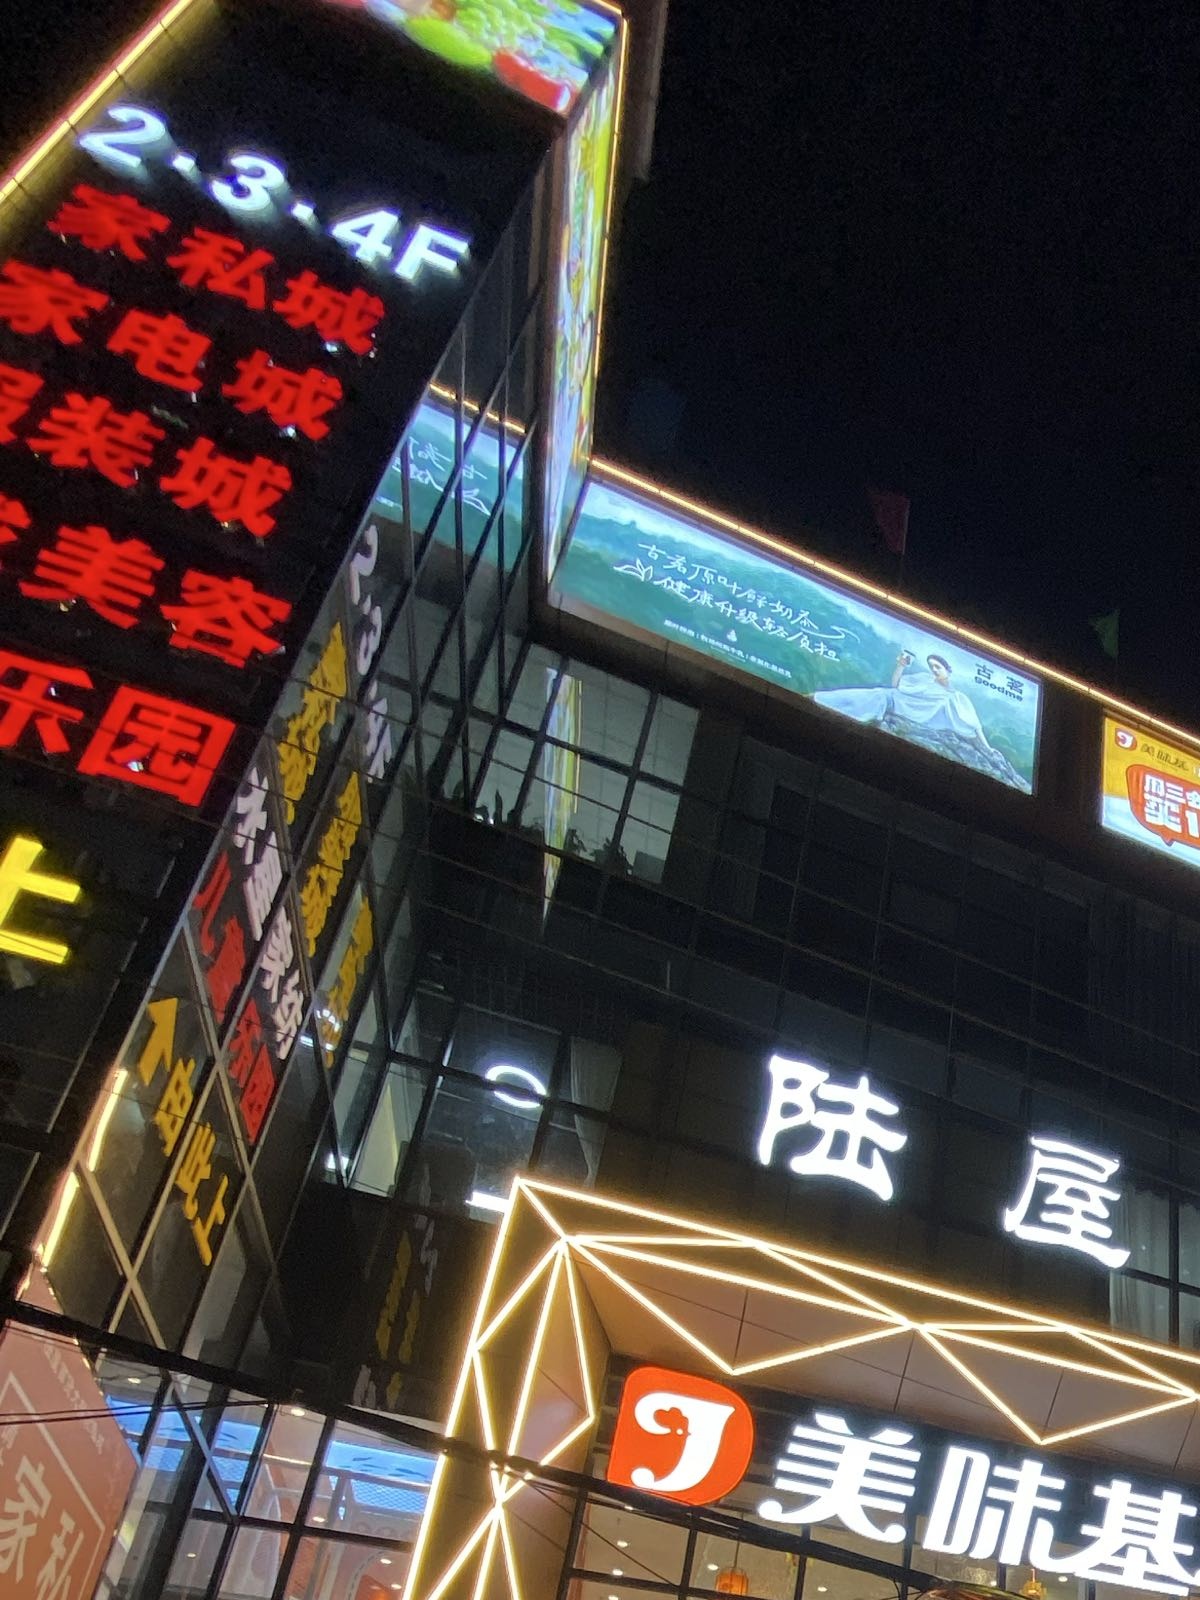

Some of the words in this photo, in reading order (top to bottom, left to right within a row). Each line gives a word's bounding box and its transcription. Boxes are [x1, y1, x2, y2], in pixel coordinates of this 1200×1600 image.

[0, 258, 344, 441] 家电城
[48, 184, 386, 356] 家私城
[0, 490, 292, 666] 美容
[975, 663, 1024, 695] 古茗
